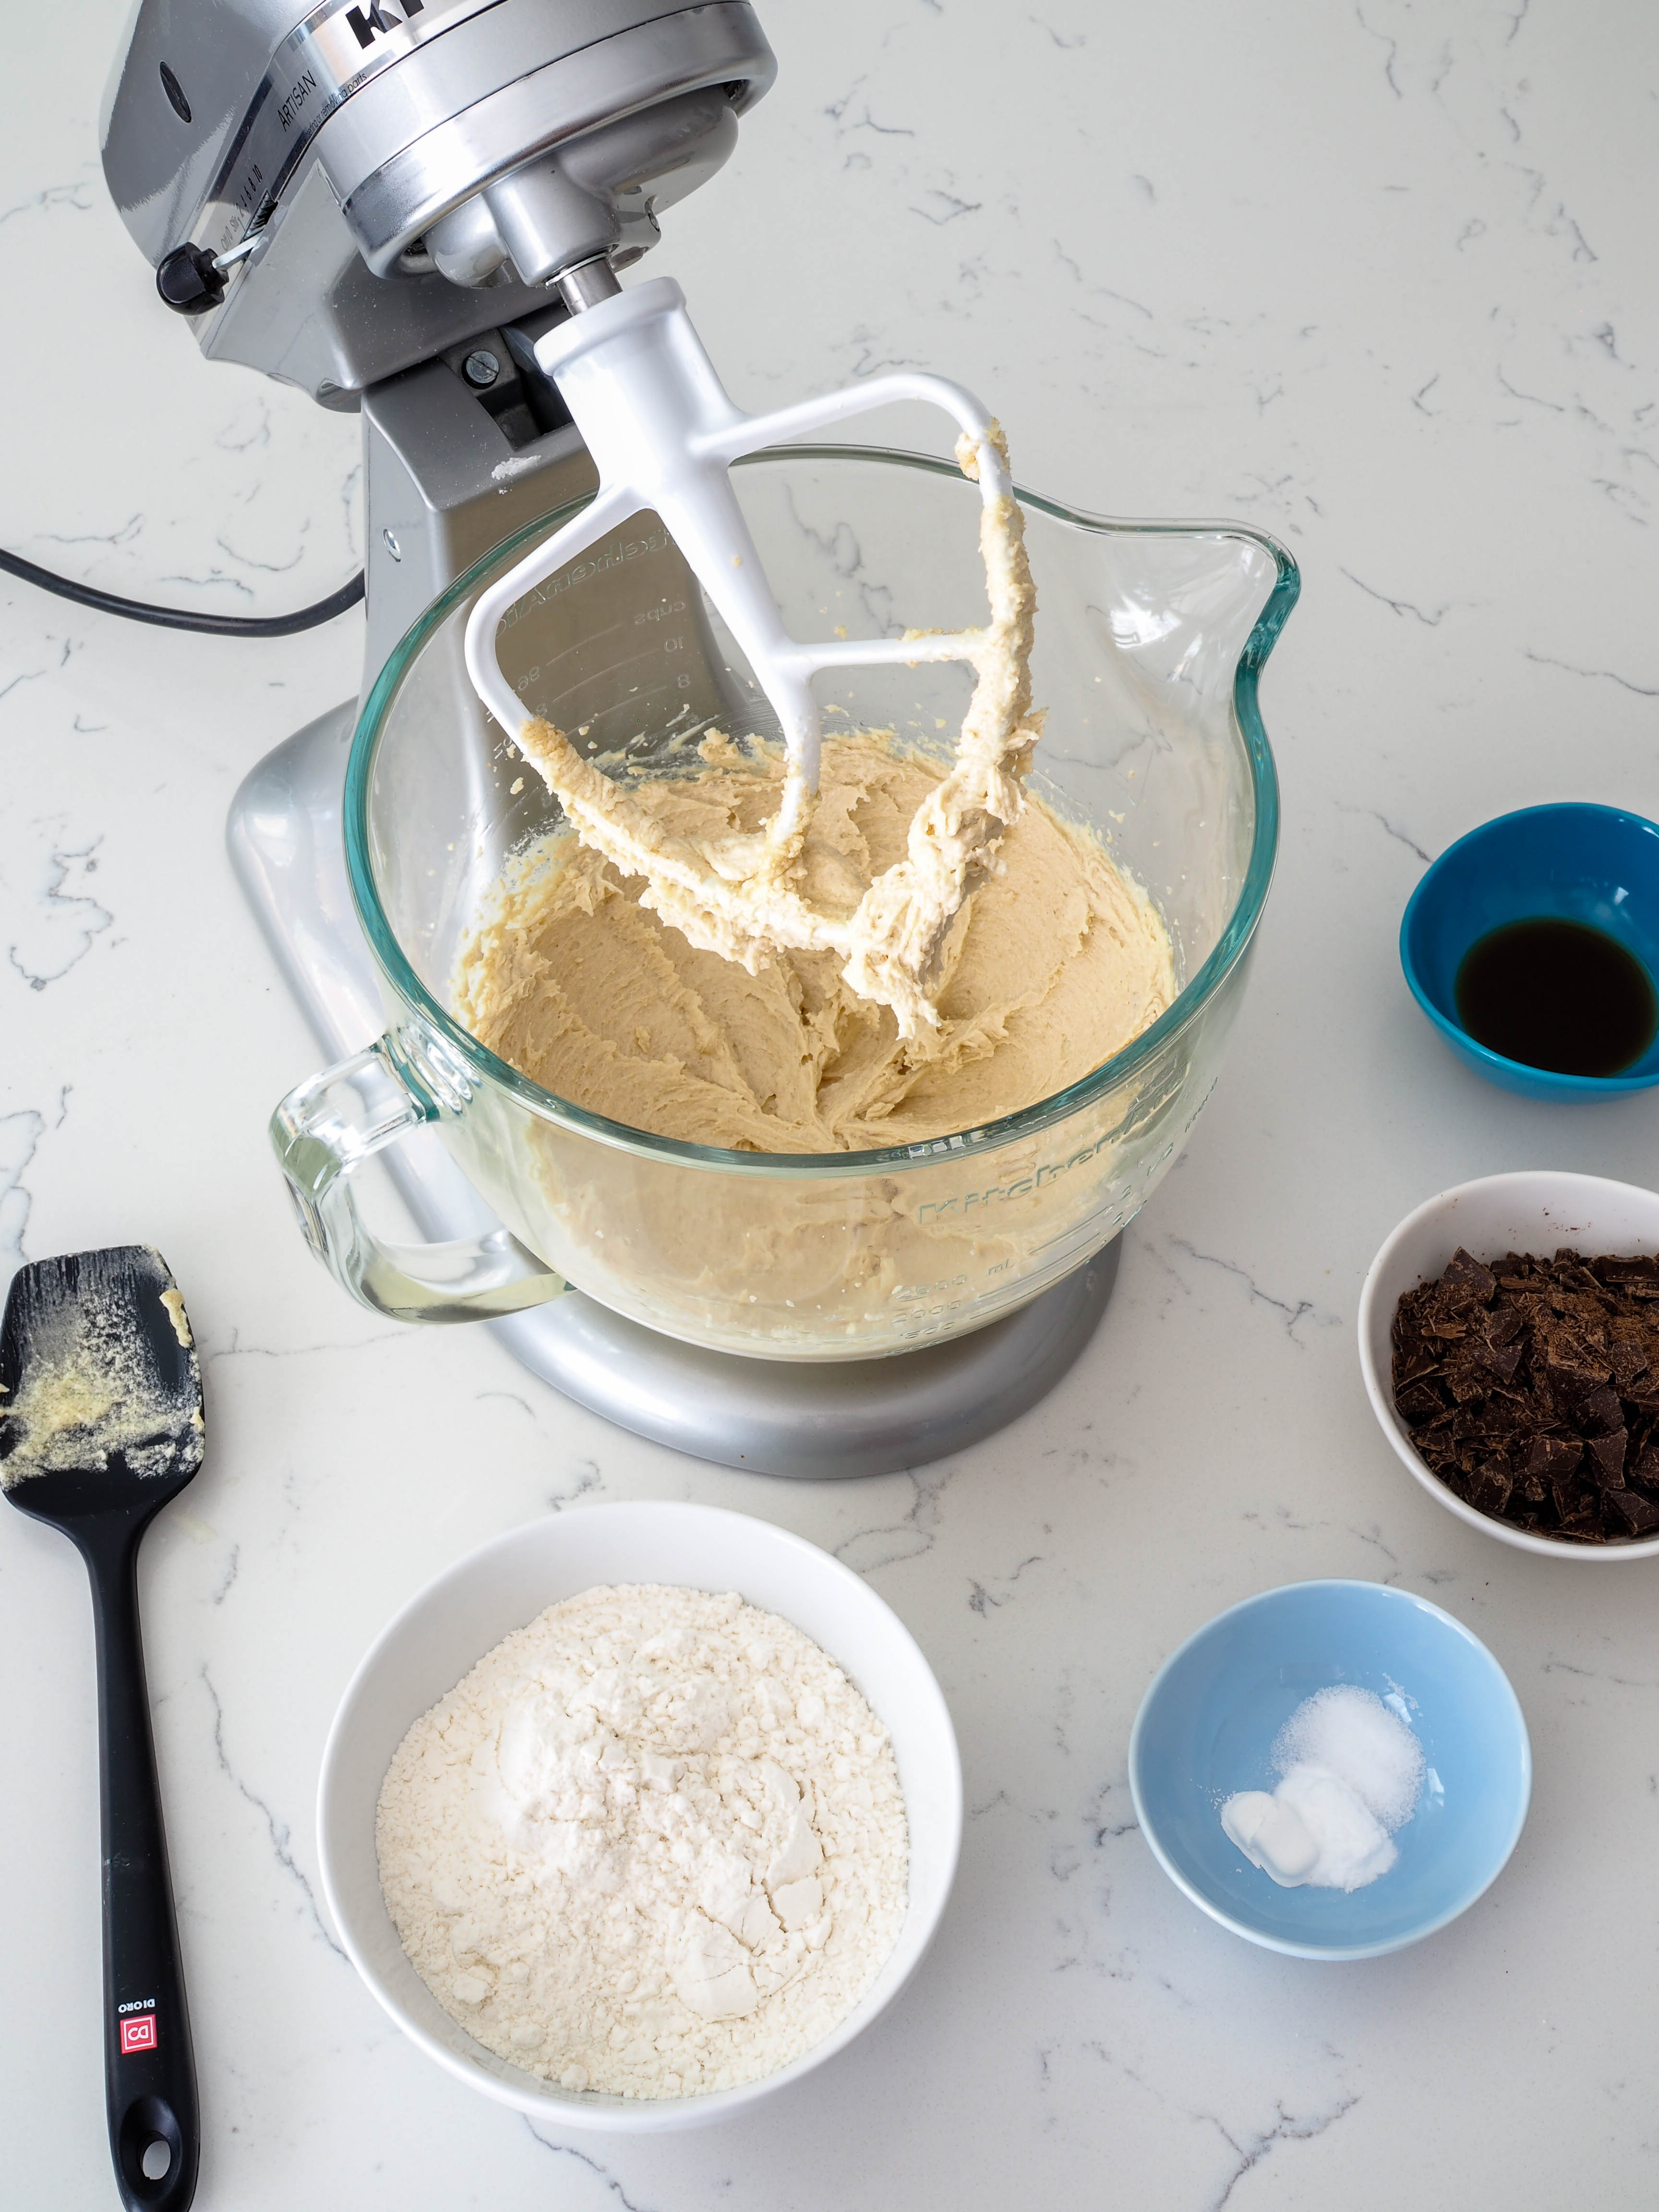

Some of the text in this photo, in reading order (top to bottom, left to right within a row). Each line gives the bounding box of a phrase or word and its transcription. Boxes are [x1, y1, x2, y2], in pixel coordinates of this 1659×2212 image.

[347, 72, 368, 94] parts
[277, 70, 317, 132] ARTISAN
[252, 164, 264, 182] 10
